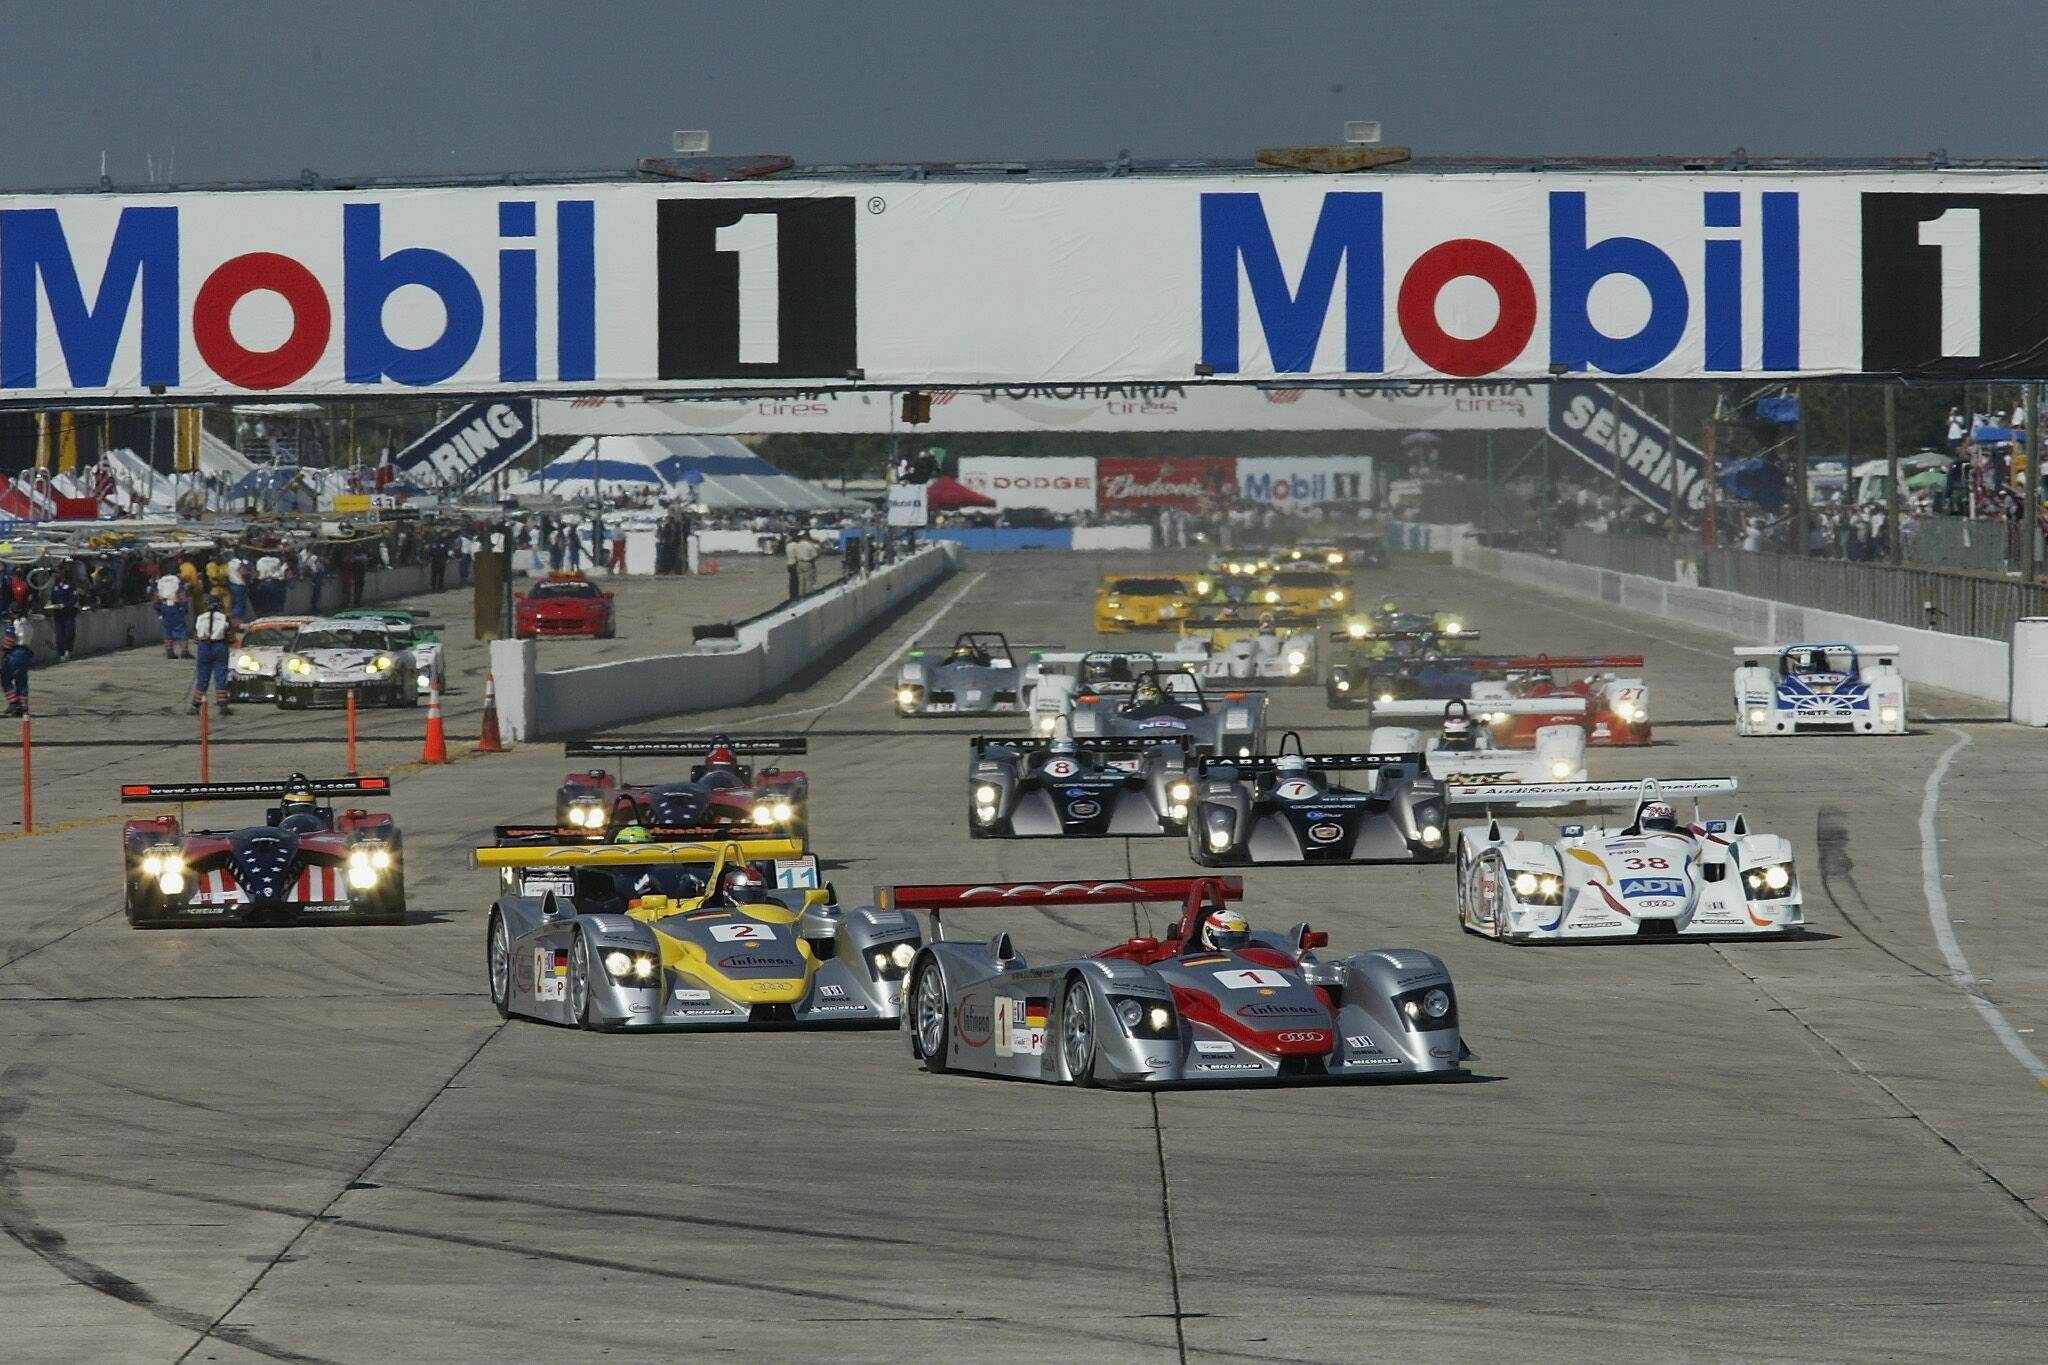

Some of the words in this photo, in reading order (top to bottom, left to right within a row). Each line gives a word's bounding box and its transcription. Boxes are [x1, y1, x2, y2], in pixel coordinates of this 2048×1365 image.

[1201, 191, 1799, 377] Mobil
[1918, 208, 1981, 358] 1
[0, 200, 595, 390] Mobil
[715, 213, 779, 365] 1
[758, 401, 828, 417] tires
[1107, 401, 1178, 415] tires
[993, 477, 1091, 489] DODGE
[1245, 473, 1326, 499] Mobil
[1619, 688, 1645, 701] 27
[1138, 720, 1187, 730] NDS
[988, 738, 1177, 747] CADIAC.COM
[1055, 762, 1070, 774] 8
[1290, 784, 1306, 795] 7
[1624, 857, 1670, 870] 38
[779, 868, 815, 889] 11
[1623, 880, 1684, 895] ADT
[730, 926, 758, 938] 2
[1240, 971, 1264, 984] 1
[998, 1003, 1006, 1046] 1
